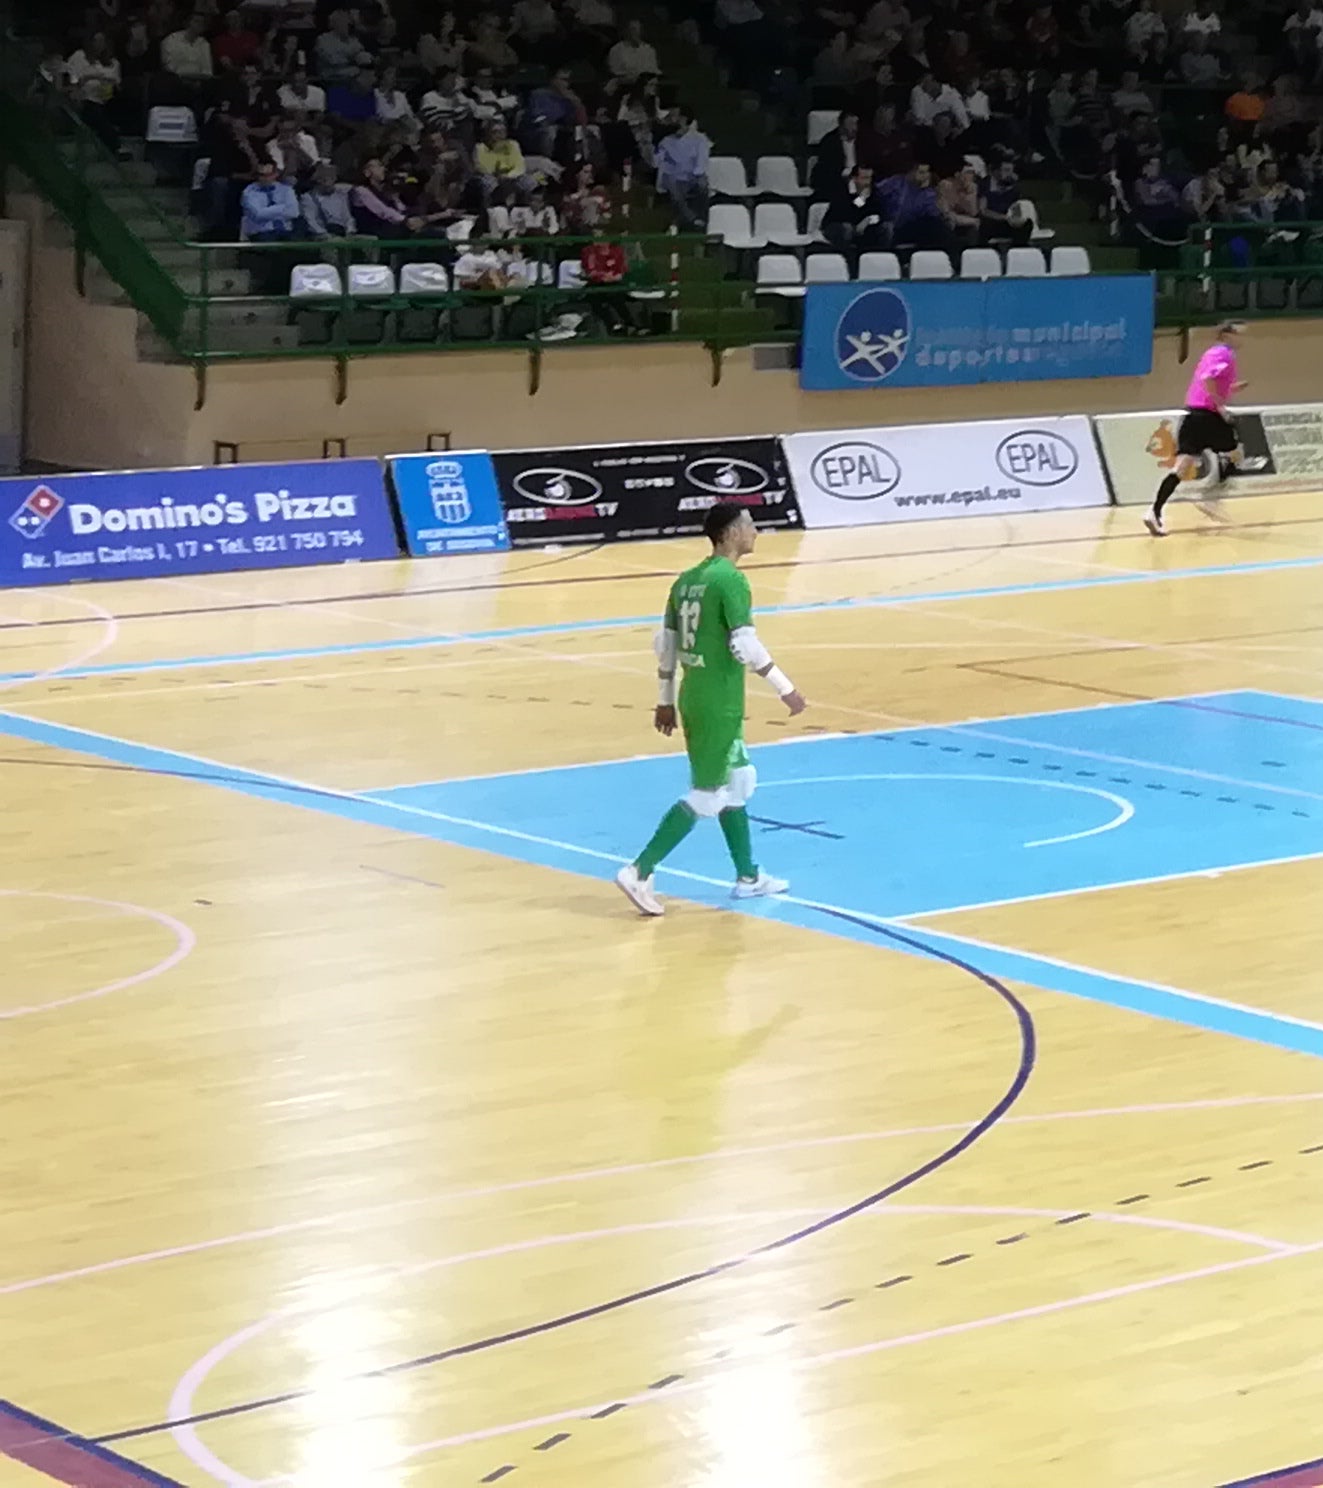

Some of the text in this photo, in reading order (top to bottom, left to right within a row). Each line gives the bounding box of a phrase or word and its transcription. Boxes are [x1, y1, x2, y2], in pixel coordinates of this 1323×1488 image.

[822, 453, 891, 489] EPAL
[1005, 442, 1069, 473] EPAL
[68, 488, 358, 535] Domino's Pizza
[894, 486, 1022, 507] www.epal.eu
[22, 552, 51, 569] Av.
[54, 550, 96, 567] Juan
[97, 545, 155, 563] Carlos
[175, 540, 198, 558] 17
[216, 537, 252, 554] Tel.
[253, 534, 288, 552] 921
[290, 531, 327, 550] 750
